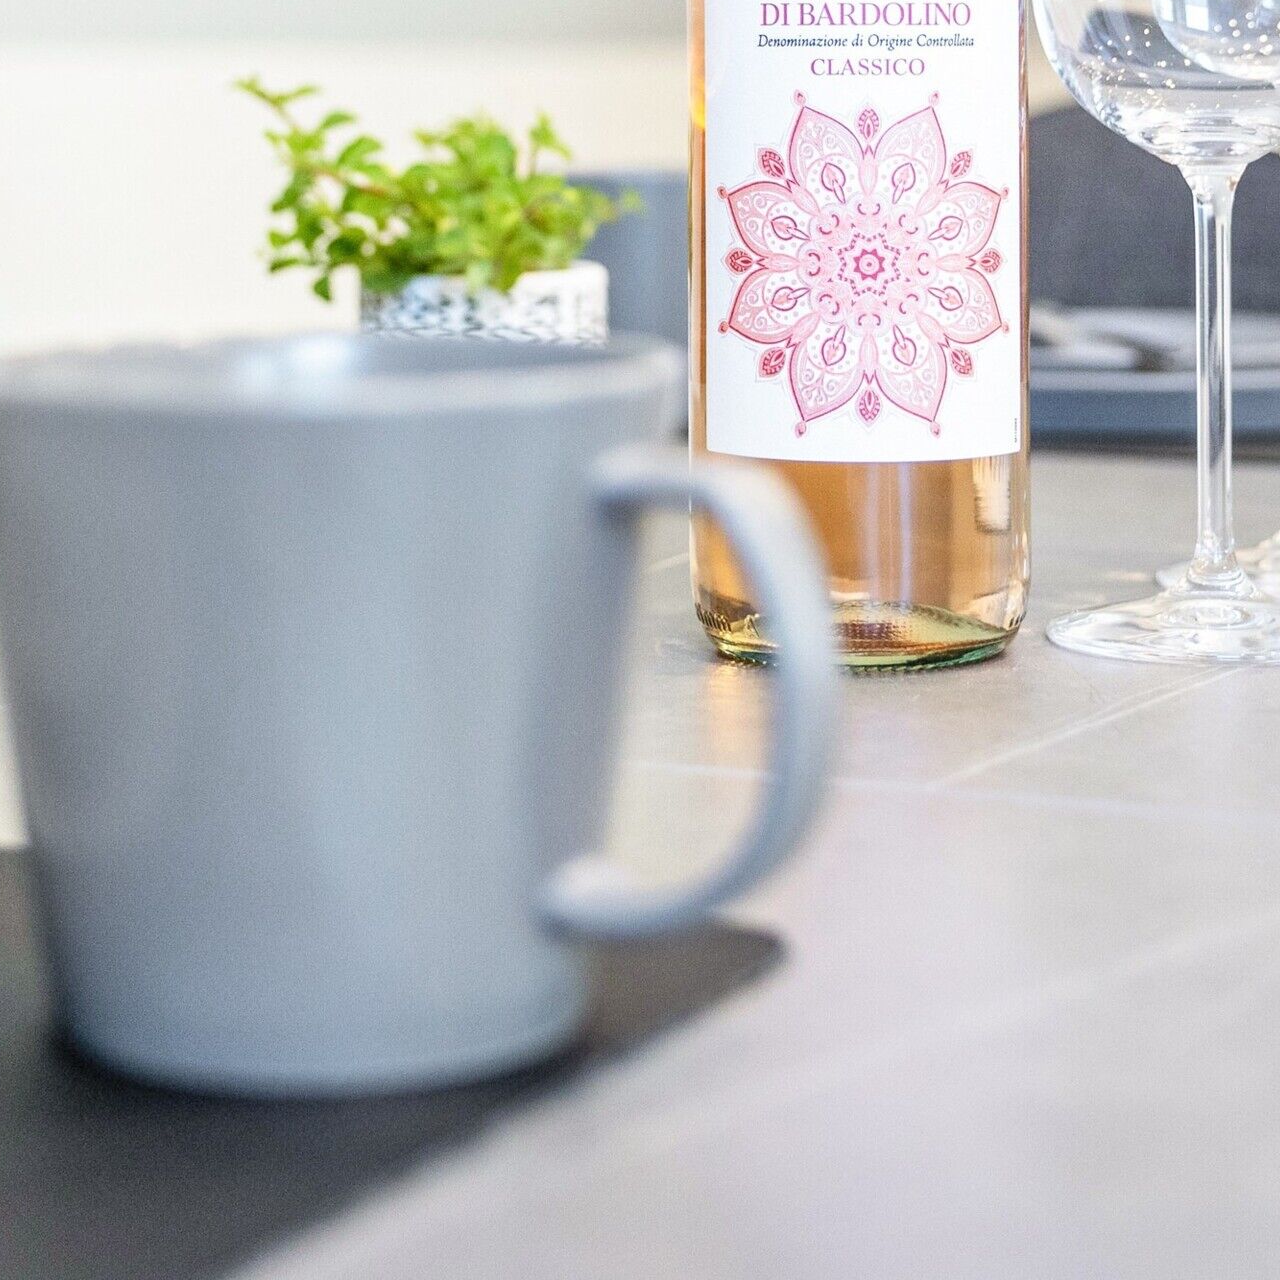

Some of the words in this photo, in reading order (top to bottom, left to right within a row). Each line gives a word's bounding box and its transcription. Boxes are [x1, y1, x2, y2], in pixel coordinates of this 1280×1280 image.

[760, 2, 790, 26] DI
[797, 2, 971, 26] BARDOLINO
[757, 34, 848, 48] Denominazione
[851, 33, 864, 48] di
[868, 34, 912, 51] Origine
[916, 33, 974, 48] Controllata
[810, 58, 926, 76] CLASSICO
